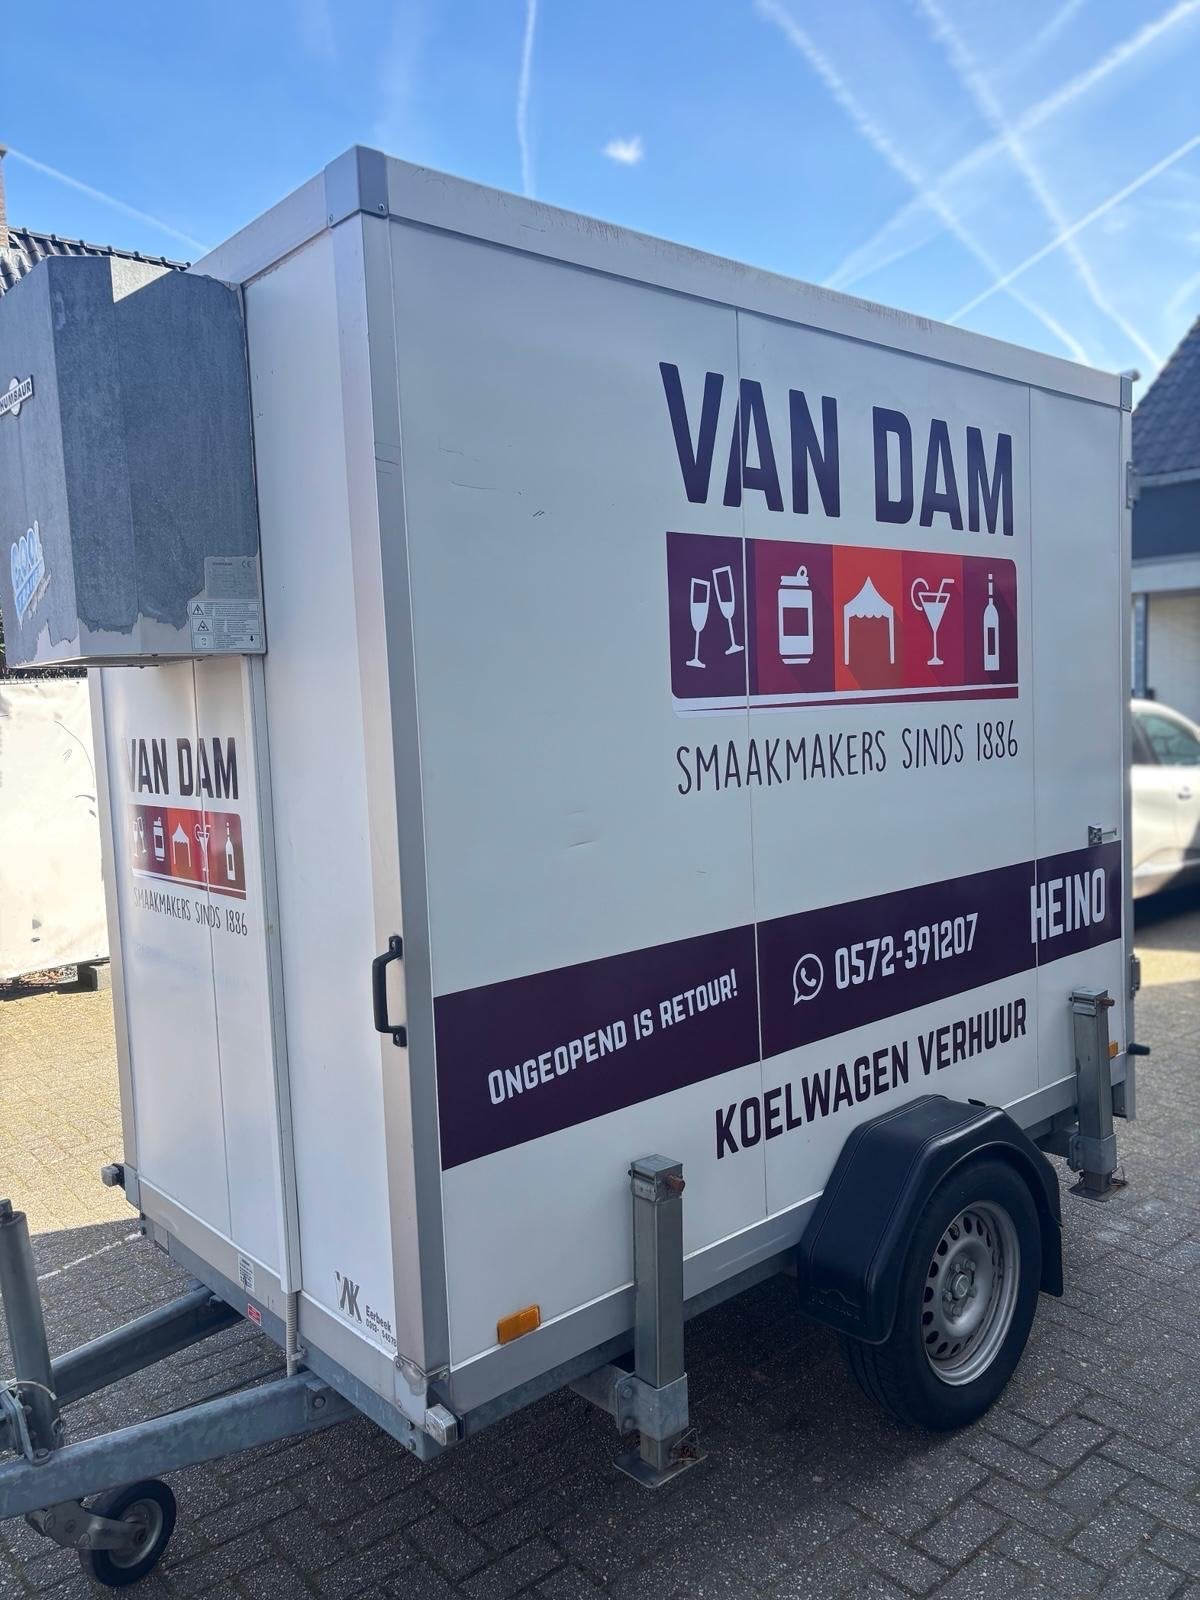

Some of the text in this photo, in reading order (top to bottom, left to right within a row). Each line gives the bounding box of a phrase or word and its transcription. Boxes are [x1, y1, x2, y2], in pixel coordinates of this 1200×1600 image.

[659, 362, 1014, 536] VAN DAM
[125, 737, 239, 799] VAN DAM
[676, 719, 1019, 795] SMAAKMAKERS SINDS 1886
[133, 886, 248, 936] SMAAKMAKERS SINDS 1886
[1030, 867, 1106, 943] HEINO
[834, 912, 979, 990] 0572-391207
[488, 968, 738, 1105] ONGEOPEND IS RETOUR!
[715, 997, 1027, 1160] KOELWAGEN VERHUUR
